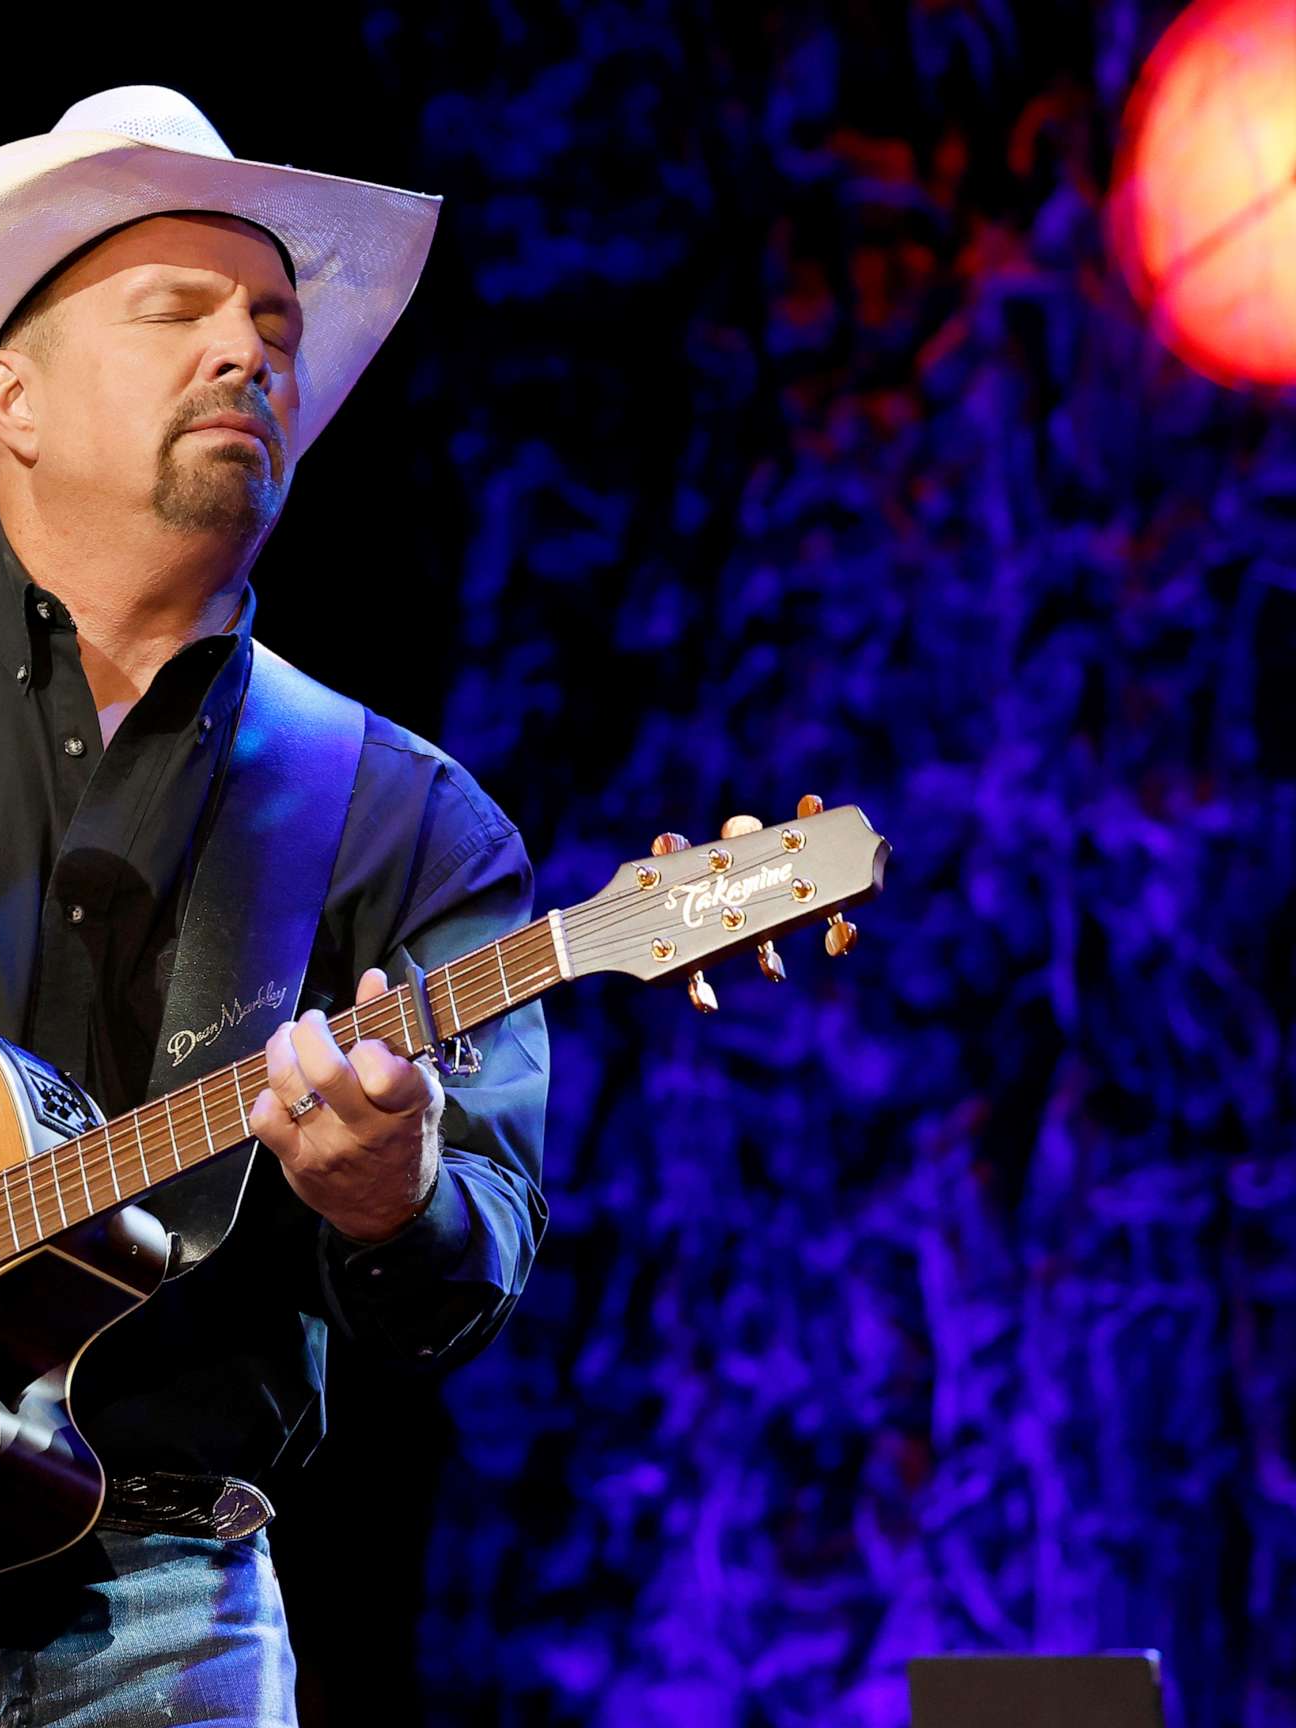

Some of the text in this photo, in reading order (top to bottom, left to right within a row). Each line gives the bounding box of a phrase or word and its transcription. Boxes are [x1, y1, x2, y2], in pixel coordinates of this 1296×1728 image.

[665, 863, 793, 928] Takamine
[167, 981, 287, 1067] Dean Markley
